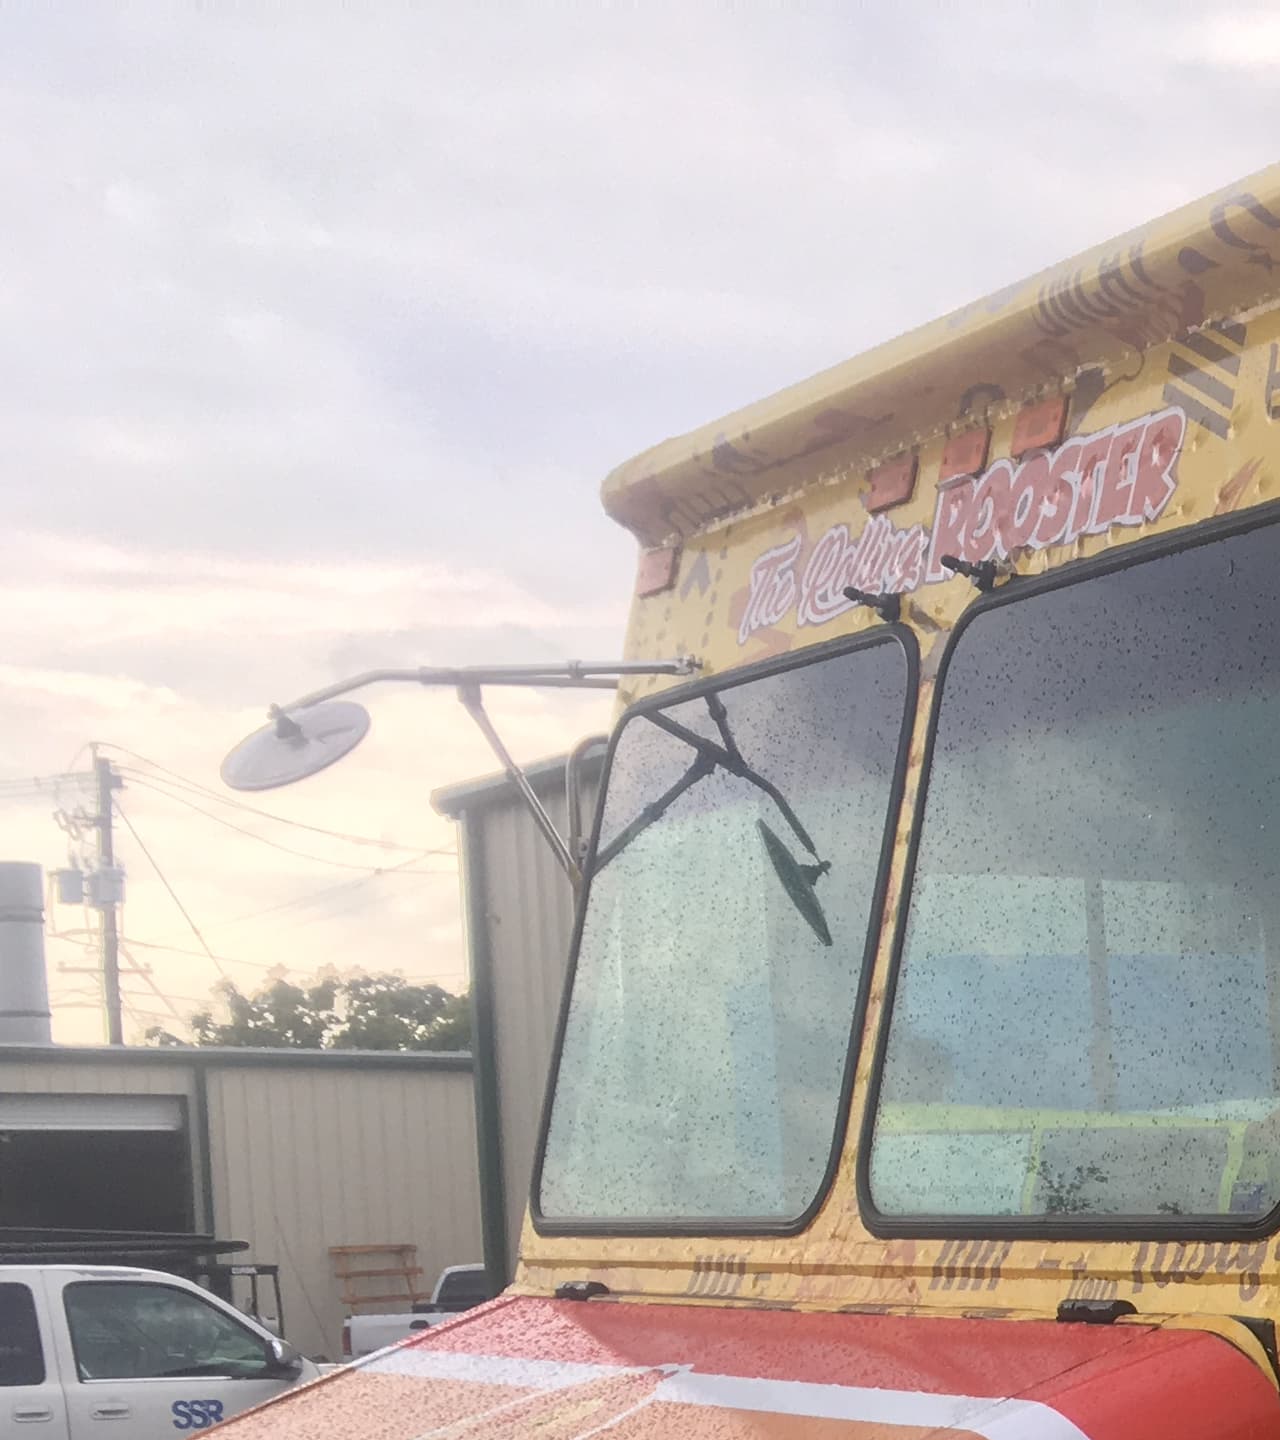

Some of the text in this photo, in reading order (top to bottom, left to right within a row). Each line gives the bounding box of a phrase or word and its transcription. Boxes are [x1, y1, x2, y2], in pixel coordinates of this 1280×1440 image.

[737, 410, 1186, 645] The Rolling ROOSTER
[172, 1399, 224, 1429] SSR
